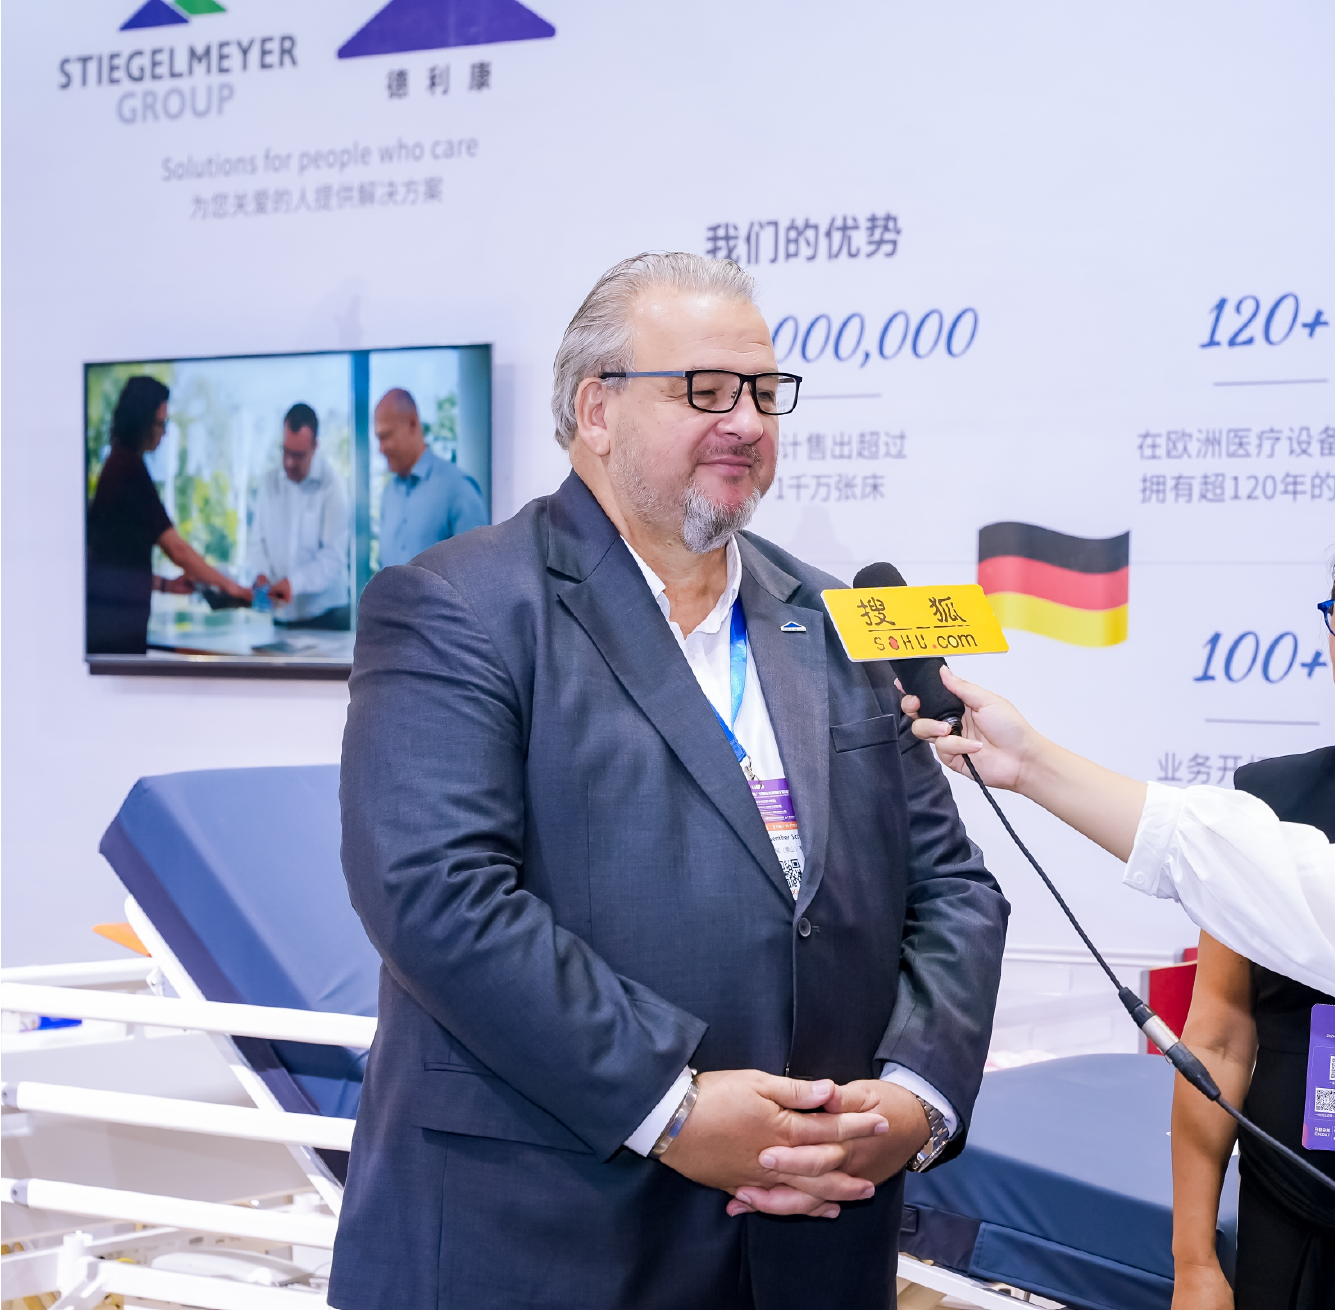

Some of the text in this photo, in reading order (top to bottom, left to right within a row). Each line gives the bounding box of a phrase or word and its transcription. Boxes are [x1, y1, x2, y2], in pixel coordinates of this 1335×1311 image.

[58, 35, 298, 91] STIEGELMEYER
[386, 61, 492, 99] 德利康
[116, 83, 235, 124] GROUP
[161, 136, 479, 182] Solutions for people who care
[705, 212, 902, 265] 我们的优势
[1199, 292, 1329, 349] 120+
[857, 596, 967, 626] 搜狐
[1192, 630, 1327, 684] 100+
